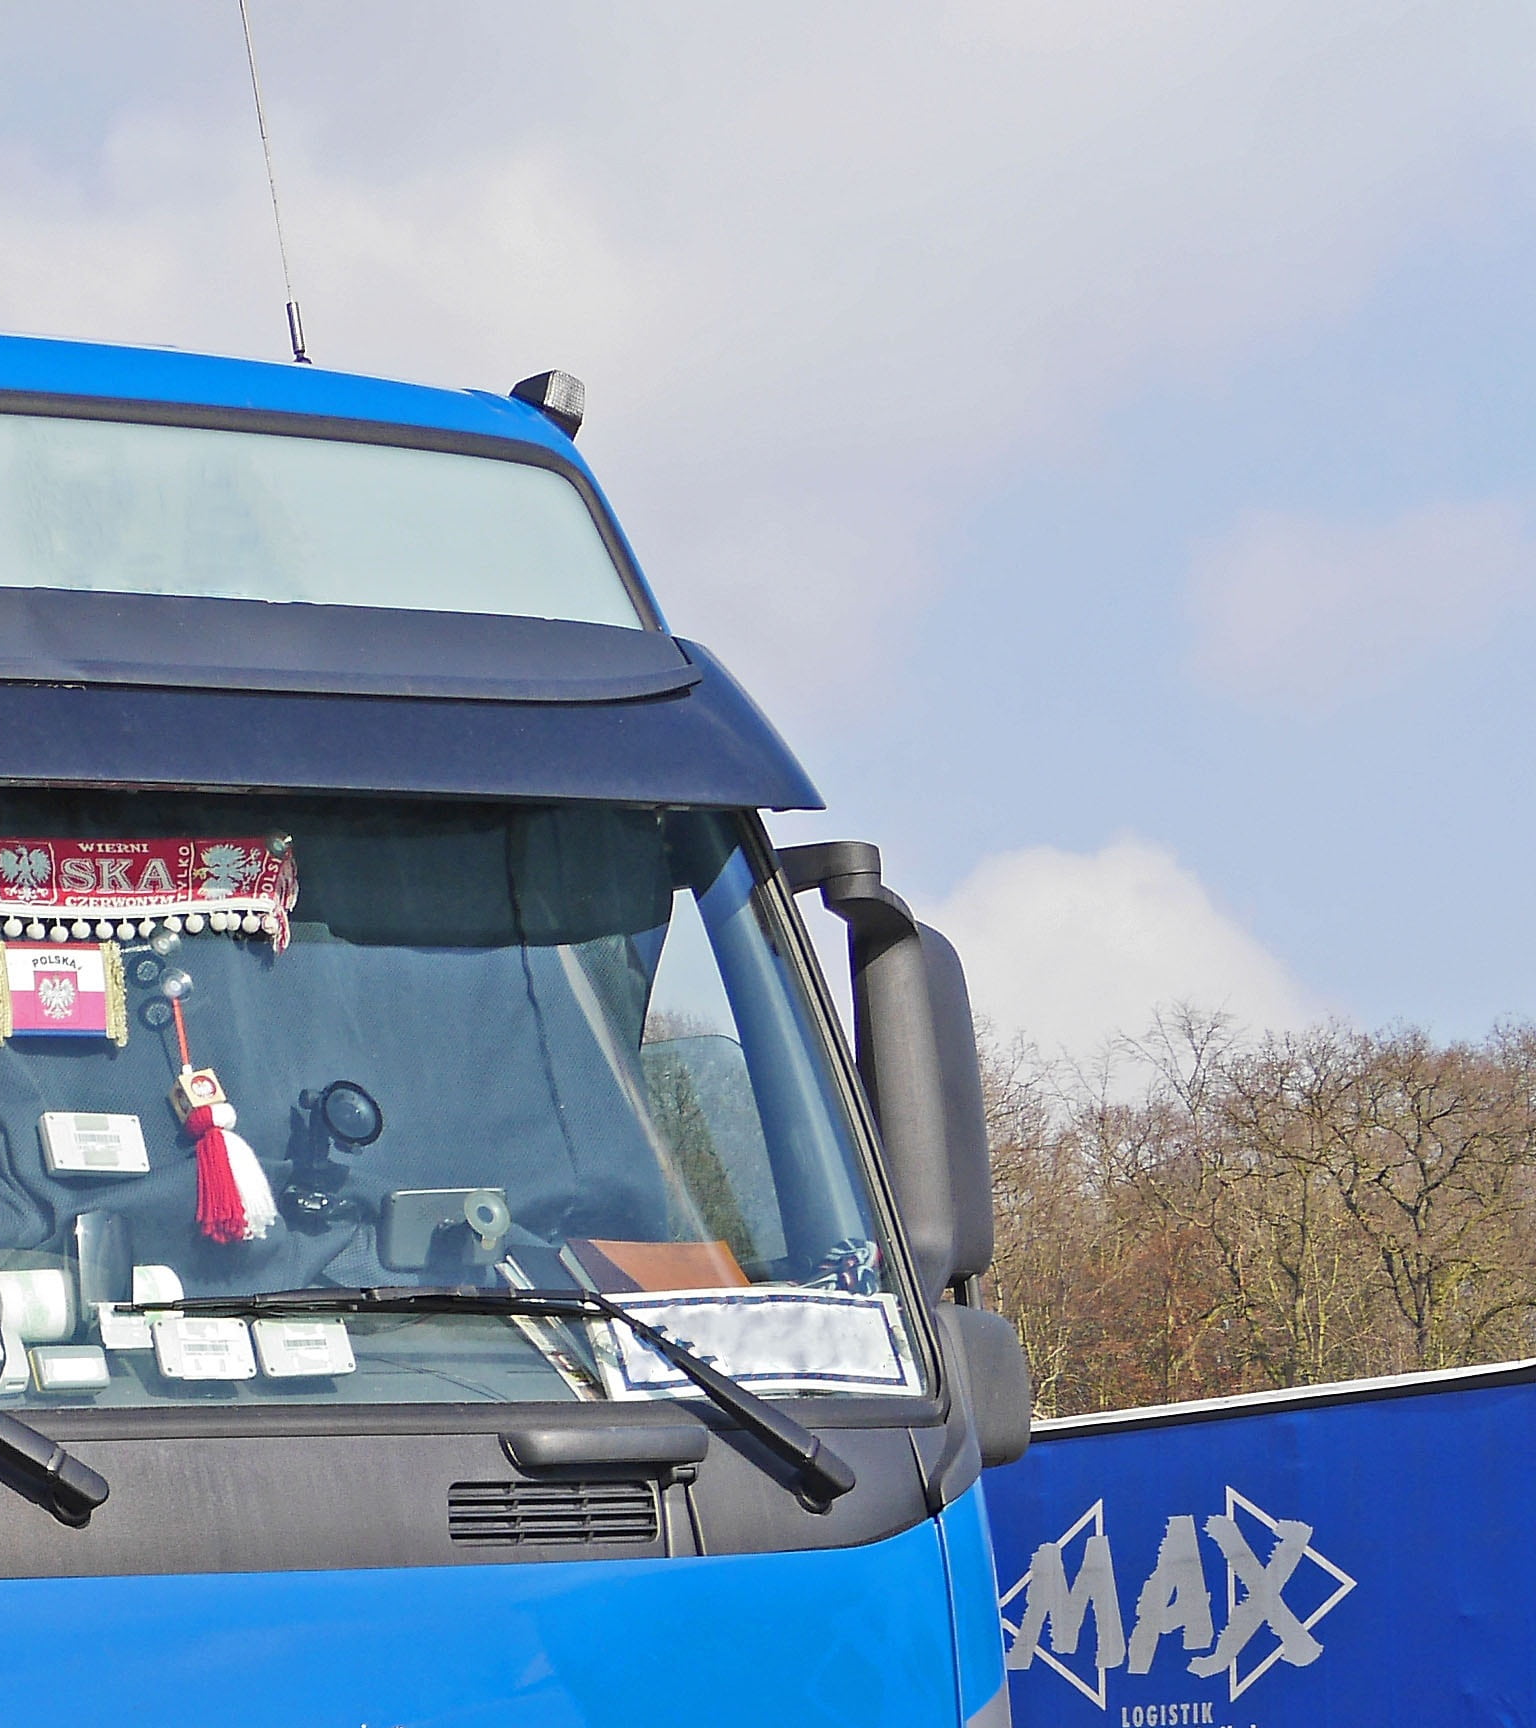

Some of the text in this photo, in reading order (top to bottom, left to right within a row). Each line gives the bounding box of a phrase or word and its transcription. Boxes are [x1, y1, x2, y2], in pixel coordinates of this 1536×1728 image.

[78, 842, 150, 854] WIERNI
[60, 857, 179, 894] SKA
[1006, 1514, 1324, 1679] MAX
[1121, 1702, 1215, 1728] LOGISTIK
